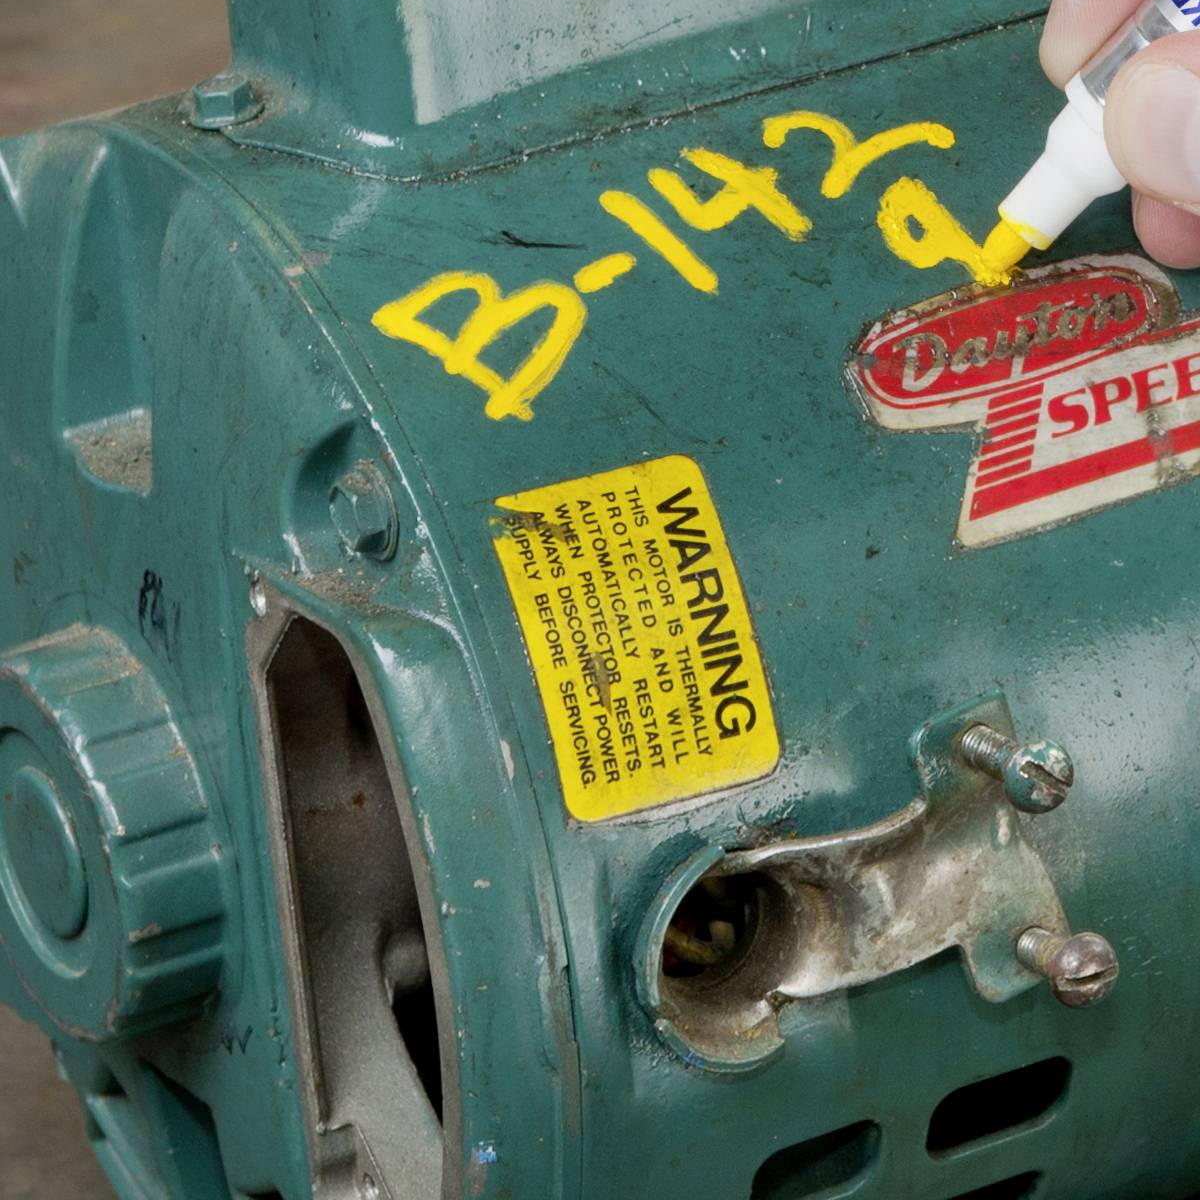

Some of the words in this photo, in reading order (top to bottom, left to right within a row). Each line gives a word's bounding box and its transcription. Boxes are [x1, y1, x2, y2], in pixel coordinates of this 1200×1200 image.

[371, 111, 955, 421] B-142
[893, 290, 1137, 393] Dayton
[576, 499, 641, 660] AUTOMATICALLY
[632, 678, 667, 769] RESTART
[601, 491, 657, 628] PROTECTED
[651, 647, 673, 693] AND
[666, 708, 690, 764] WILL
[624, 485, 649, 528] THIS
[643, 538, 675, 607] MOTOR
[656, 485, 757, 741] WARNING
[667, 618, 684, 637] IS
[503, 514, 543, 582] SUPPLY
[534, 593, 568, 670] BEFORE
[559, 680, 597, 790] SERVICING.
[530, 511, 566, 579] ALWAYS
[557, 585, 605, 708] DISCONNECT
[593, 714, 621, 785] POWER
[555, 503, 585, 560] WHEN
[577, 570, 621, 684] PROTECTOR
[613, 697, 642, 779] RESETS.
[675, 645, 713, 757] THERMALLY
